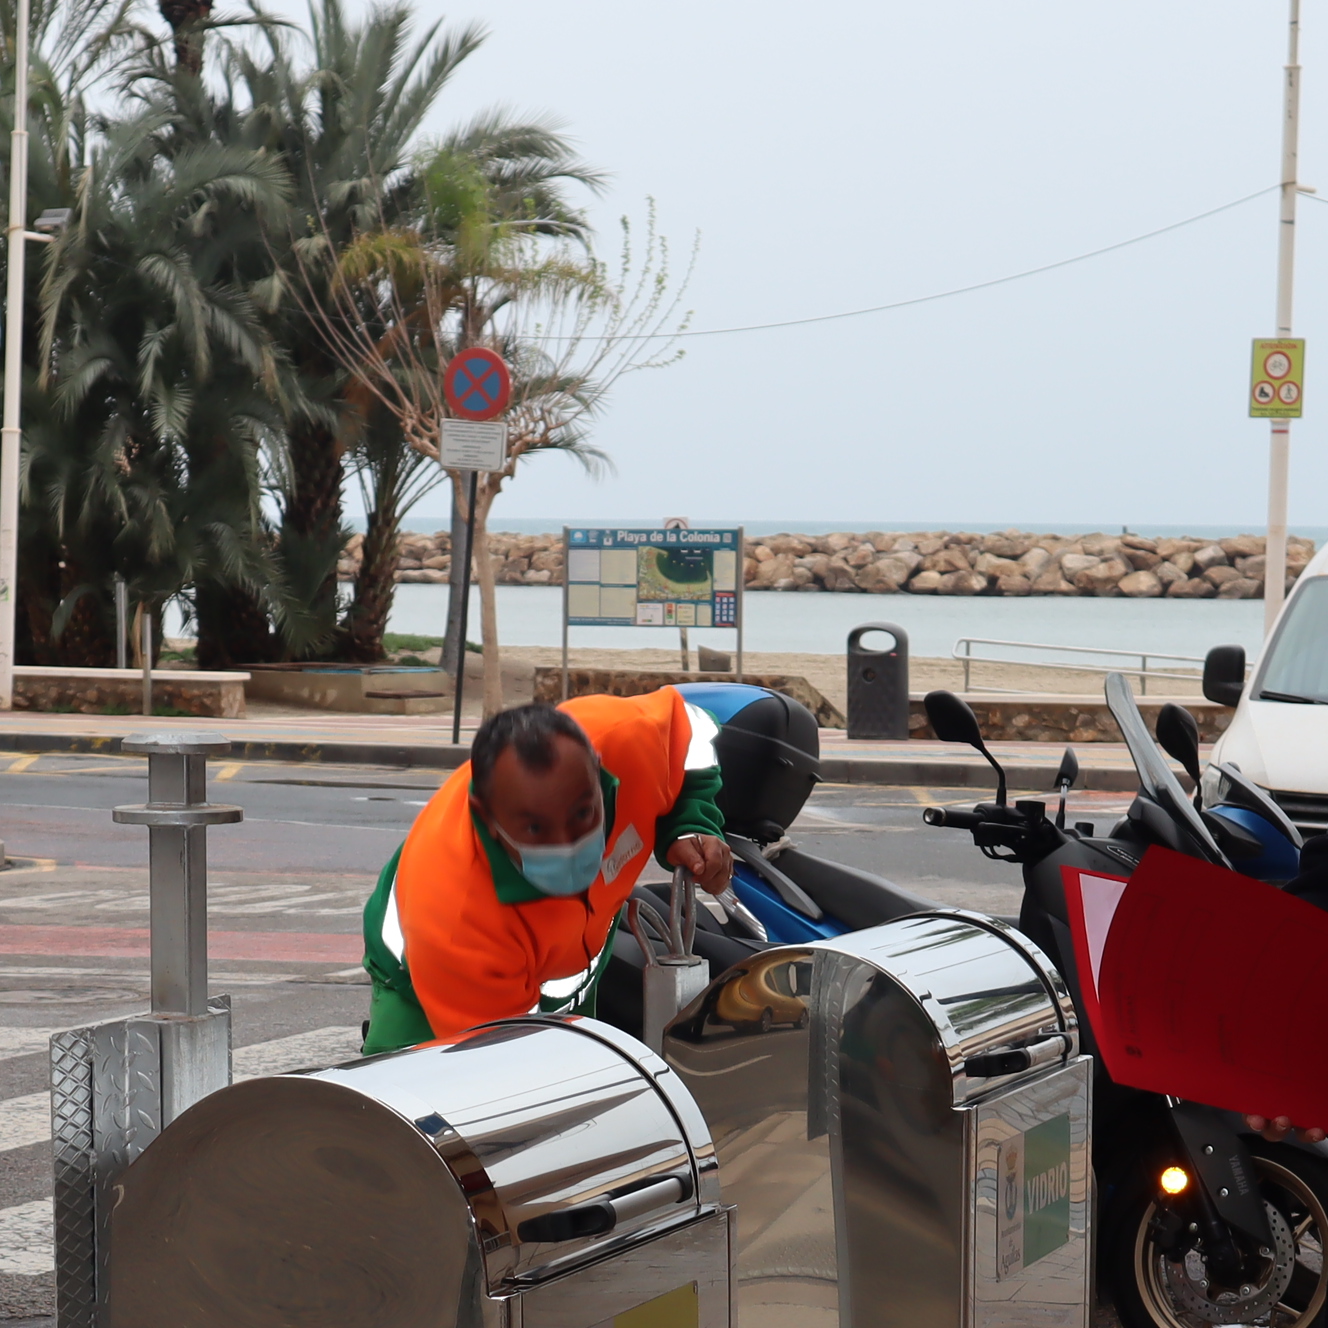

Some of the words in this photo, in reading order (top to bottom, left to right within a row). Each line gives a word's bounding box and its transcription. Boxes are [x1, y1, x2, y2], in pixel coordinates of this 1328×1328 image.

[616, 530, 647, 545] Playa
[649, 530, 664, 543] de
[666, 530, 677, 543] la
[679, 530, 721, 543] Colonia
[1027, 1161, 1068, 1215] VIDRIO
[1228, 1154, 1250, 1196] YAMAHA
